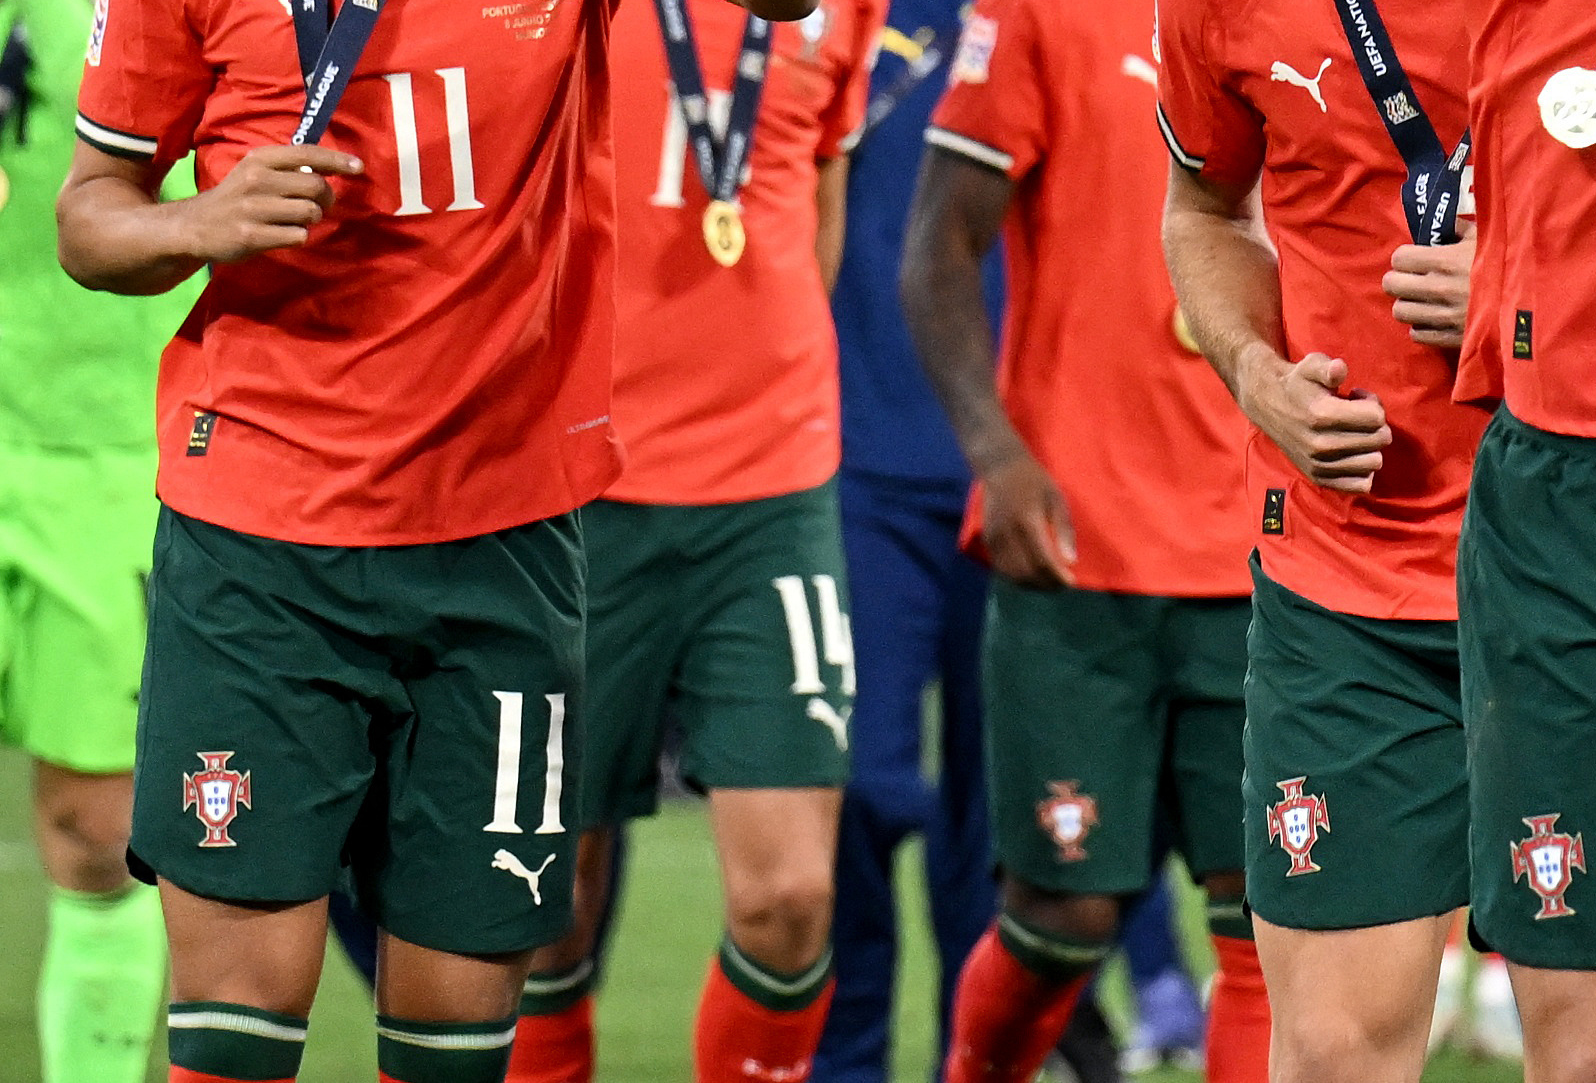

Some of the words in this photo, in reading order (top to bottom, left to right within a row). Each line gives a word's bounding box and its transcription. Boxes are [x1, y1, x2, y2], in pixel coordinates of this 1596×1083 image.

[305, 60, 340, 116] LEAGUE
[1366, 36, 1387, 77] UEFA
[382, 66, 486, 216] 11
[1429, 191, 1451, 231] UEFA
[771, 574, 857, 695] 14
[482, 690, 566, 834] 11
